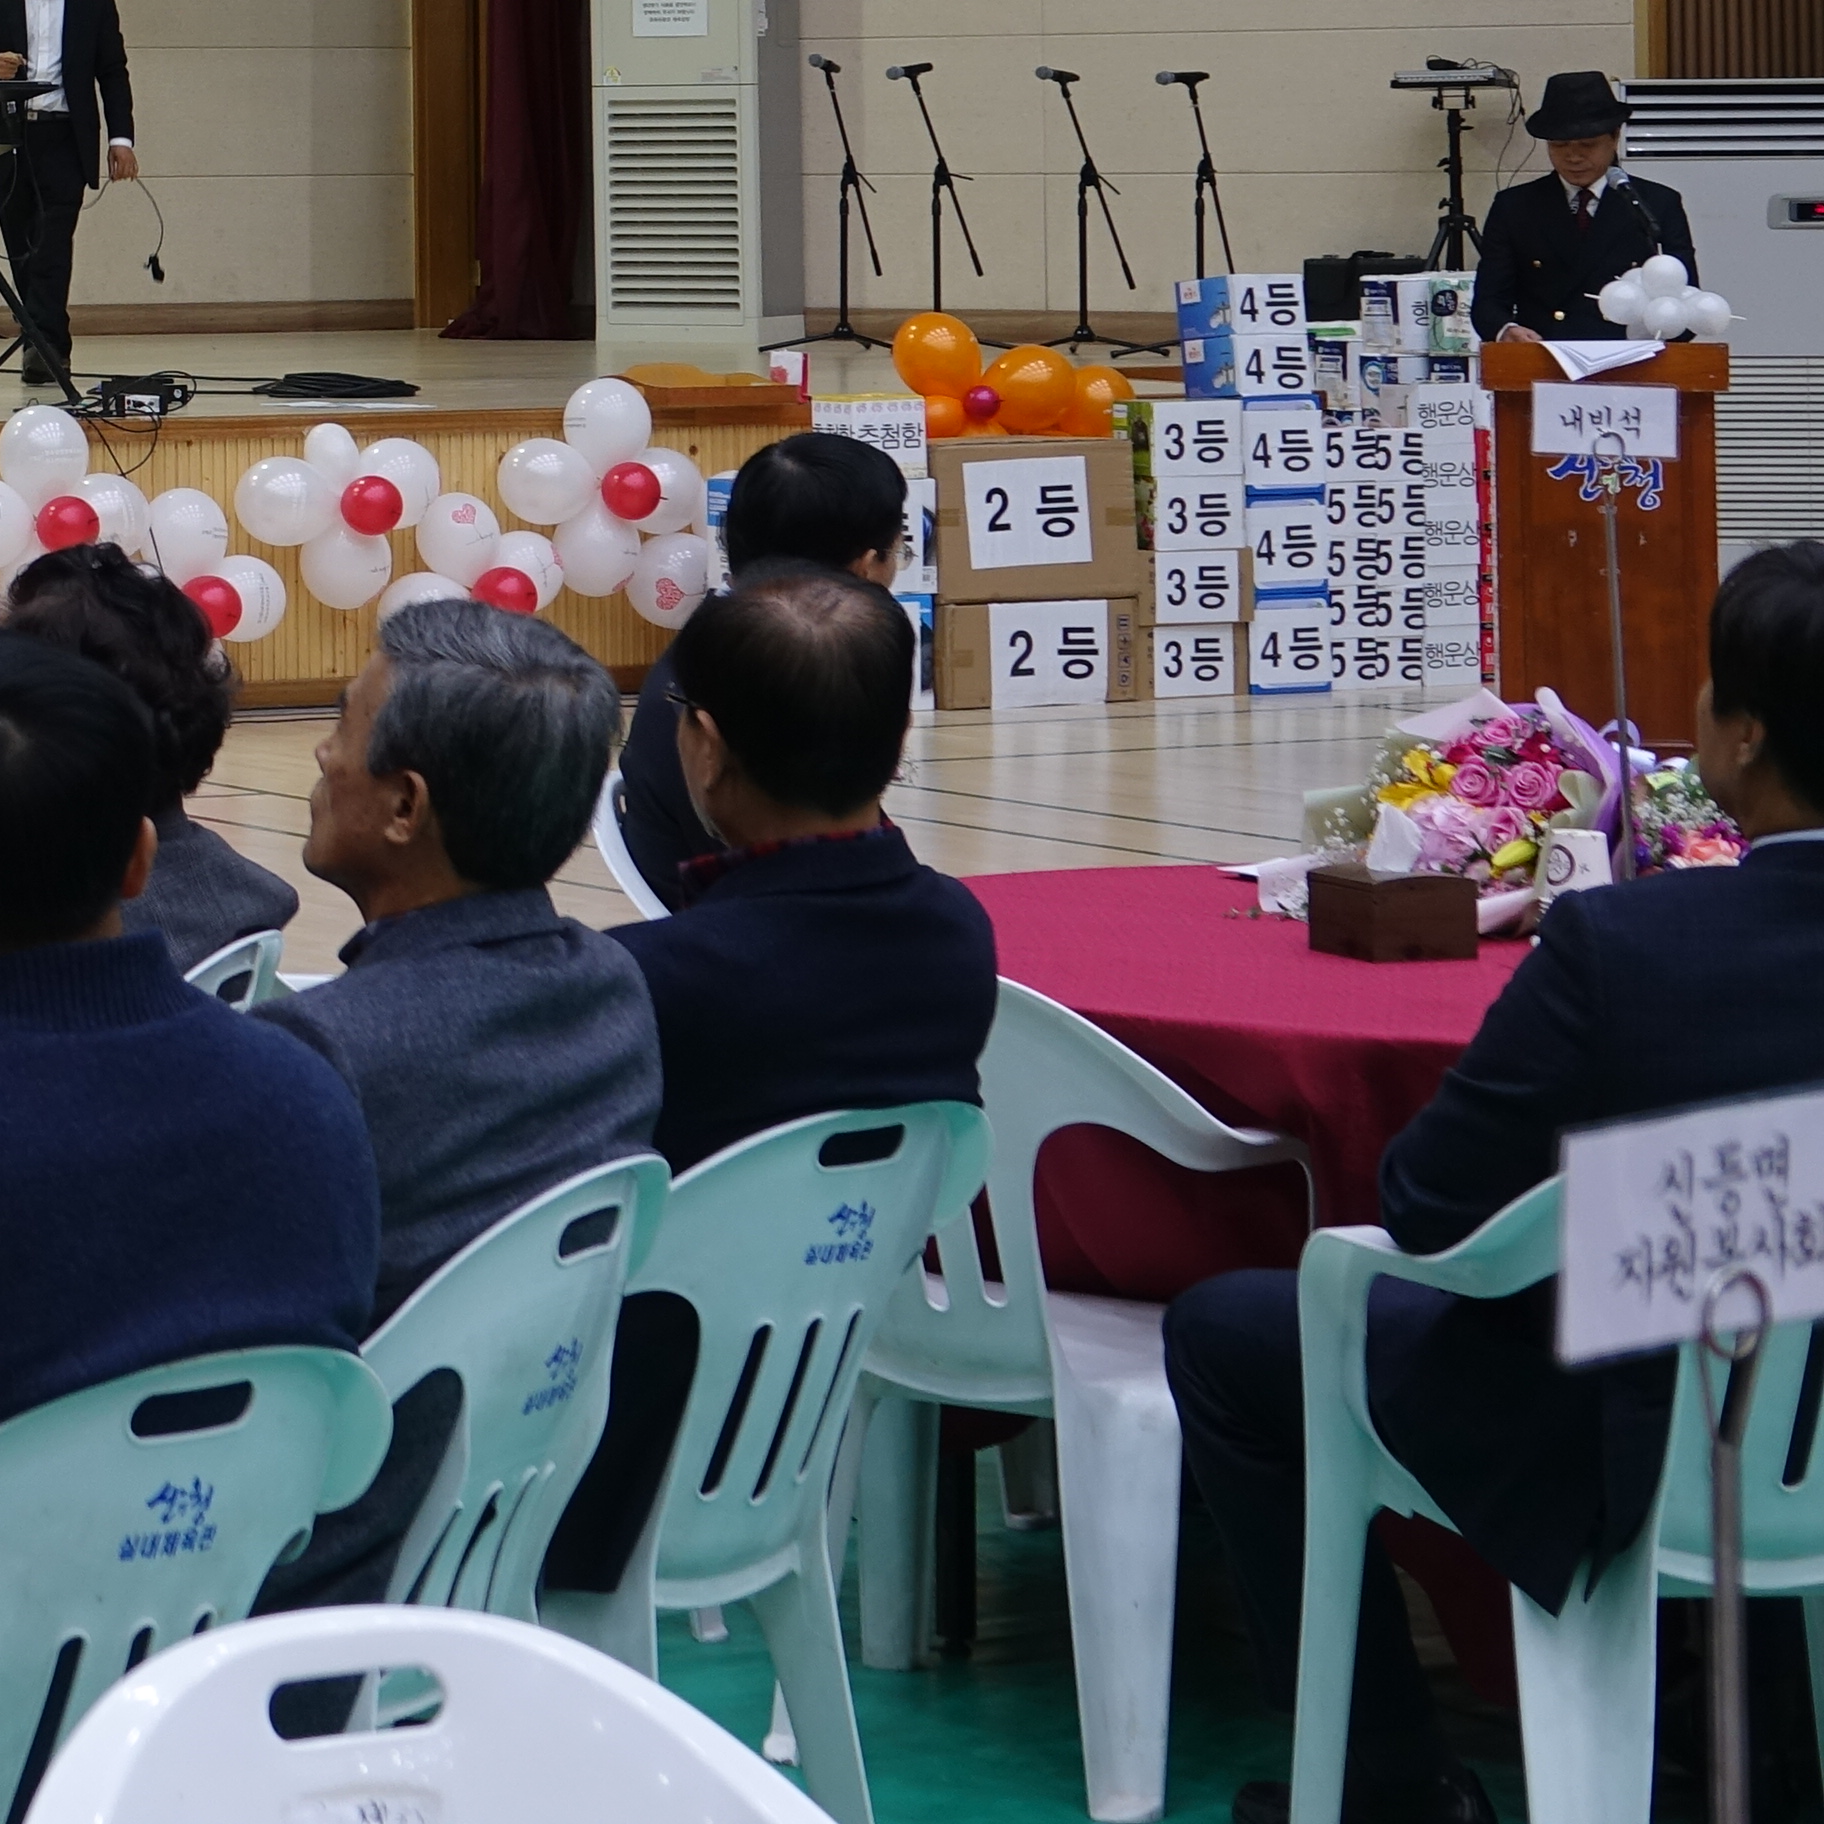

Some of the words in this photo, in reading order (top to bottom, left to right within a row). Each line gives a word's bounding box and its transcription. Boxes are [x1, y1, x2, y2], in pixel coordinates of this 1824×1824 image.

[1417, 399, 1475, 429] 행운상
[1559, 405, 1642, 439] 내빈석
[857, 423, 924, 450] 추첨함
[1422, 462, 1478, 488] 행운상
[1424, 521, 1481, 546] 행운상
[1423, 581, 1481, 608] 행운상
[1425, 641, 1481, 669] 행운상
